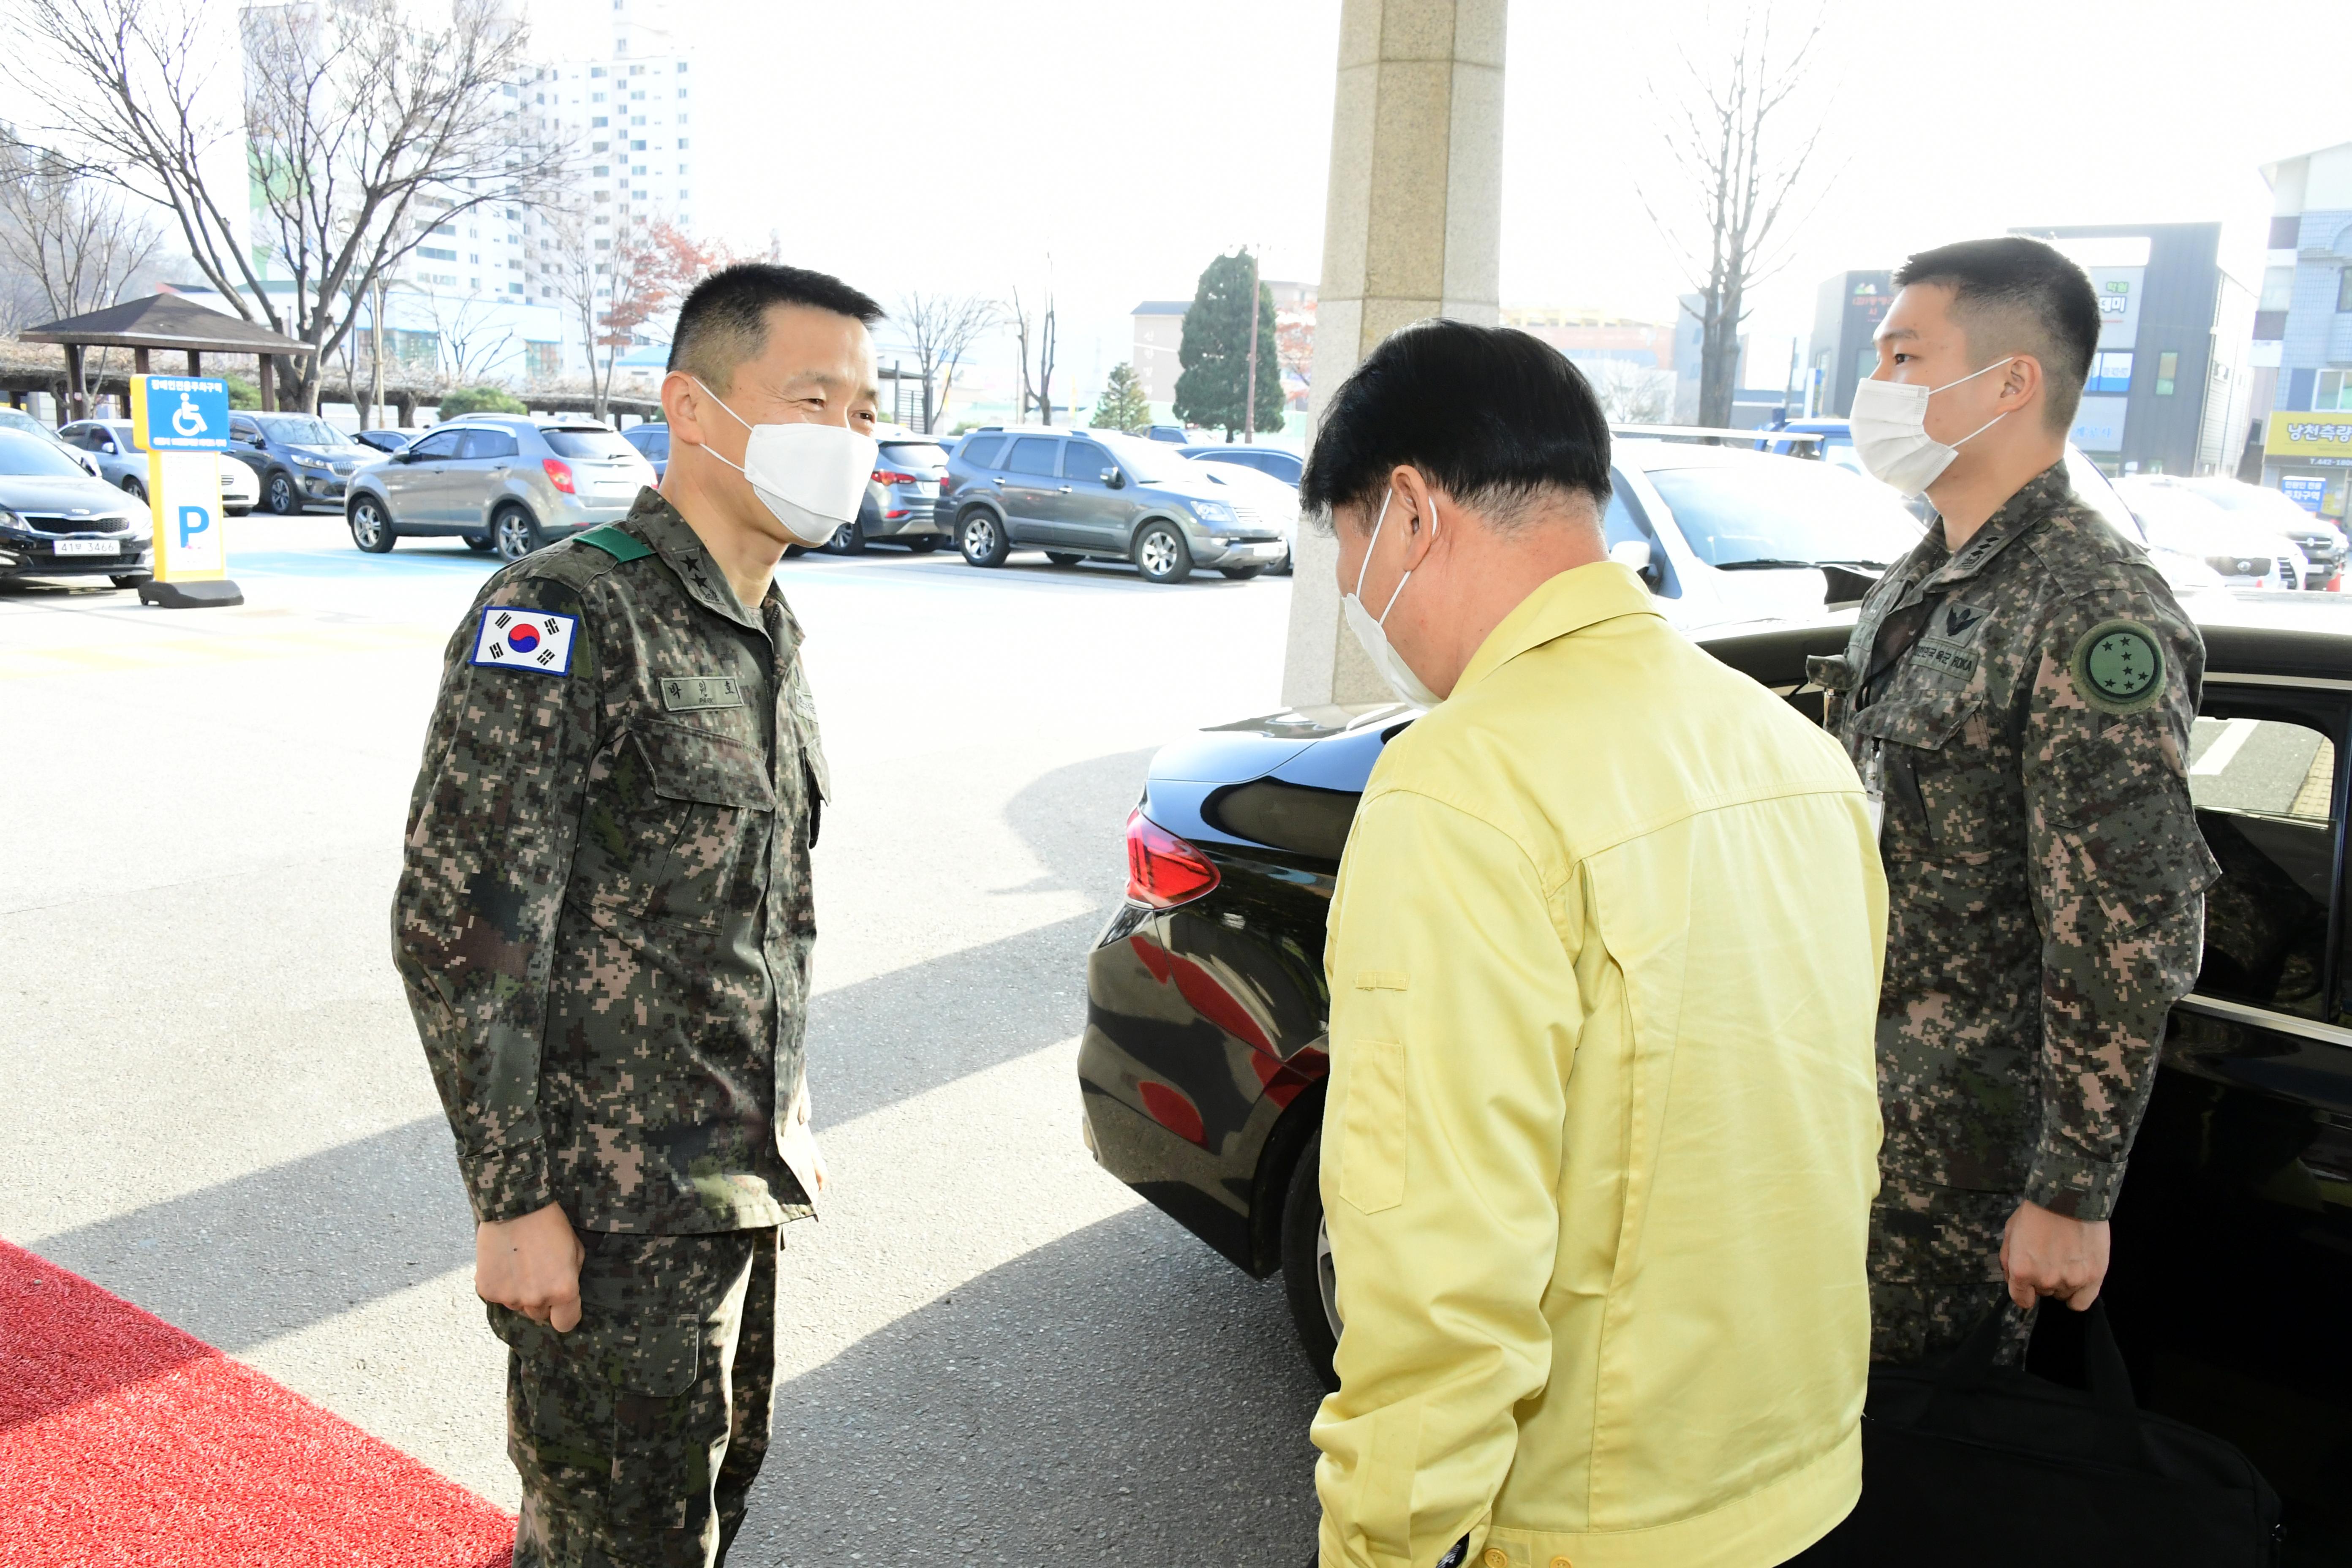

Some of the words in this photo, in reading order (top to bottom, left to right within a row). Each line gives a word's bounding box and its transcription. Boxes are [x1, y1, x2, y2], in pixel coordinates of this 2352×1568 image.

[178, 506, 210, 548] P
[87, 542, 114, 552] 3466
[1950, 656, 1972, 672] ROKA
